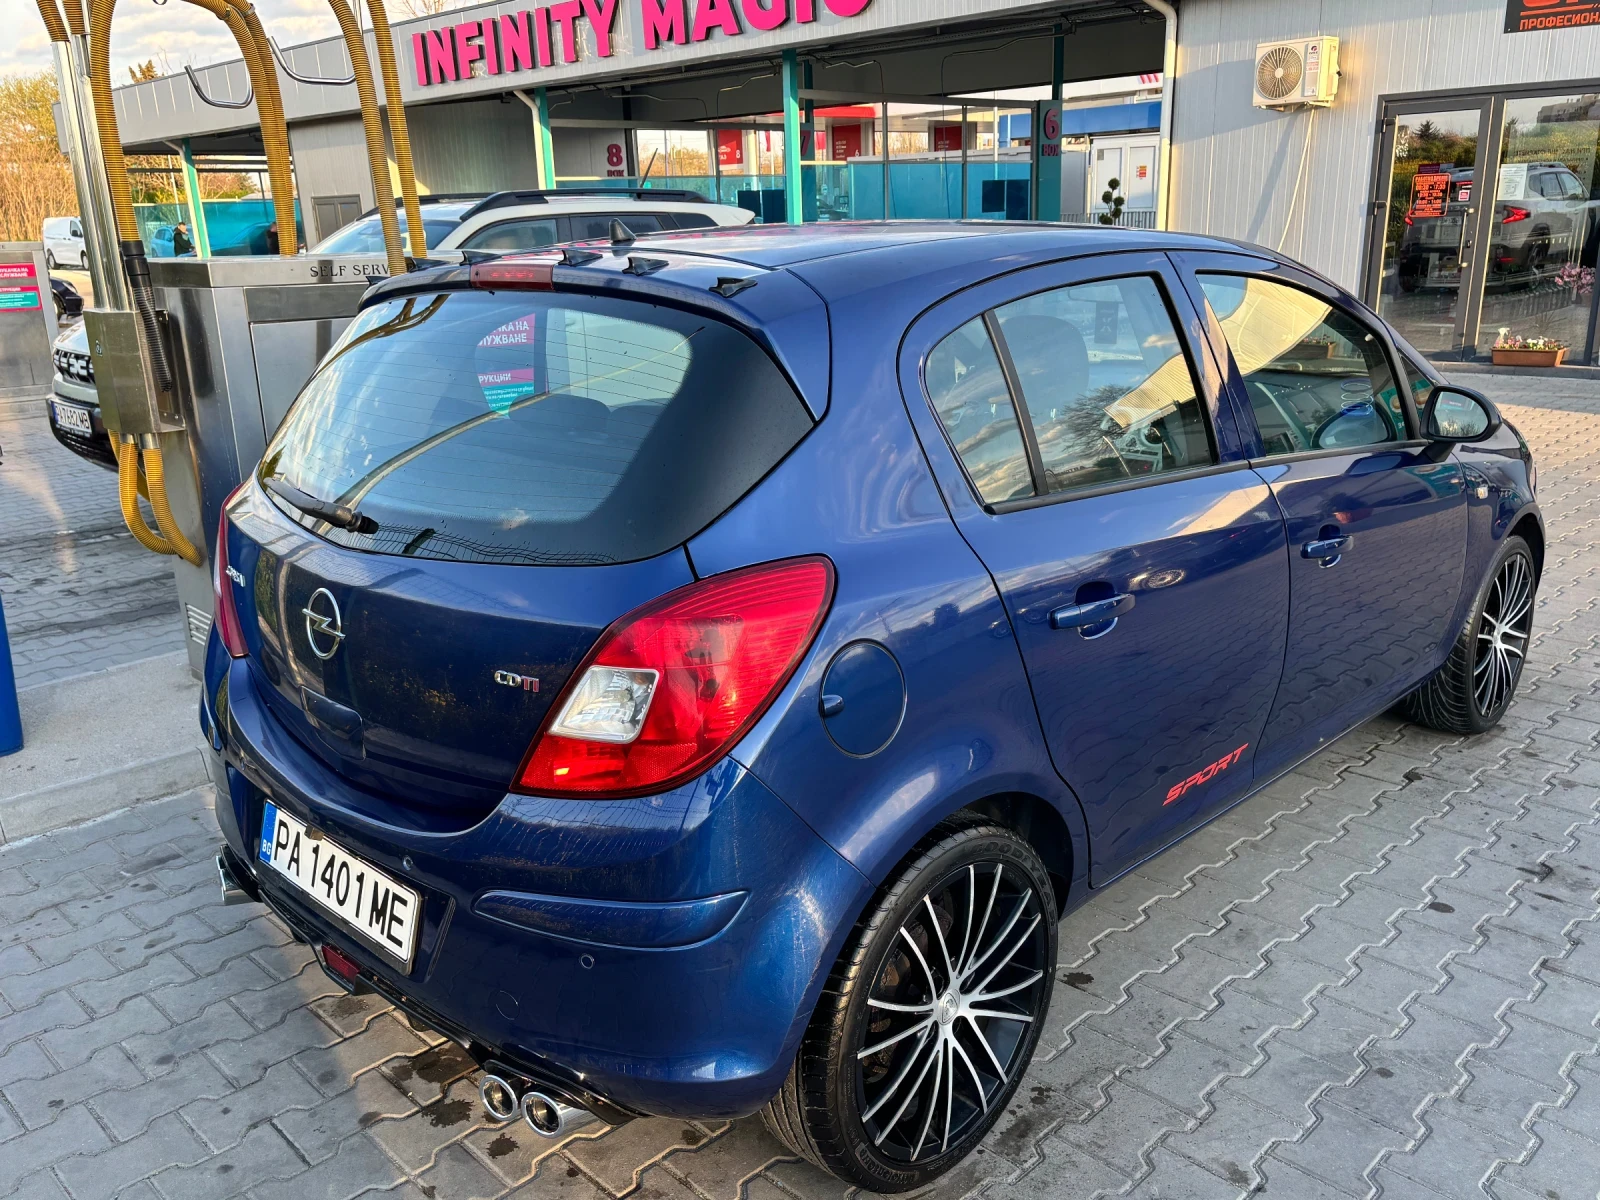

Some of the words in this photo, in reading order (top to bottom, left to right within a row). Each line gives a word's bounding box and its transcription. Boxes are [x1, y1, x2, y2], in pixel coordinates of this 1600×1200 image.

[1520, 12, 1600, 31] ПРОФЕСИОН
[412, 0, 622, 86] INFINITY
[641, 0, 872, 49] MAG
[1044, 108, 1060, 140] 6
[607, 143, 623, 167] 8
[310, 265, 347, 278] SELF
[353, 263, 389, 276] SERV
[516, 320, 530, 331] НА
[494, 670, 540, 693] CDTI
[1162, 743, 1249, 807] SPORT
[261, 839, 272, 856] BG
